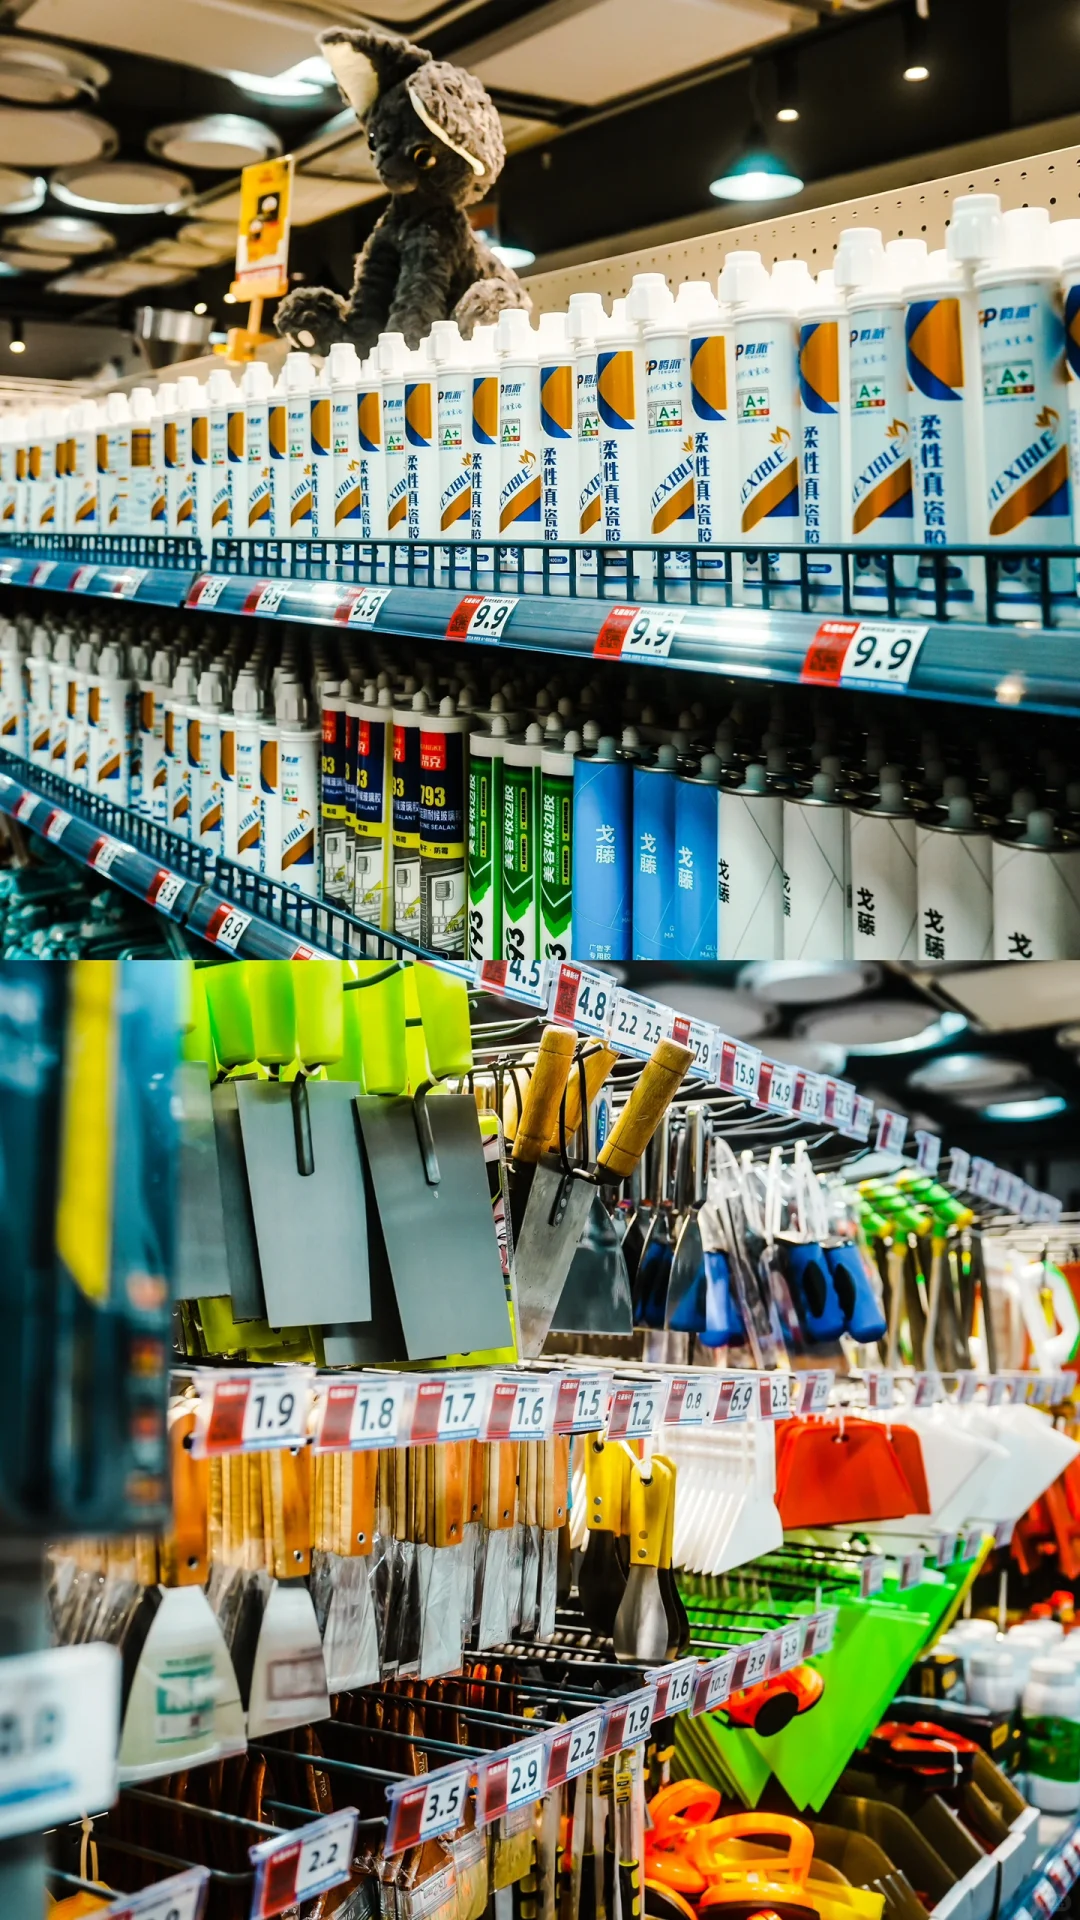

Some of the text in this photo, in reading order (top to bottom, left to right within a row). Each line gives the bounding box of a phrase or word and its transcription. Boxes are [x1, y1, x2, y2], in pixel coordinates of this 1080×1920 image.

[1001, 368, 1029, 384] A+
[746, 395, 765, 408] A+
[859, 384, 881, 398] A+
[584, 418, 598, 429] A+
[659, 406, 679, 419] A+
[388, 435, 401, 444] A+
[444, 429, 459, 439] A+
[503, 424, 518, 435] A+
[602, 439, 621, 541] 柔性真瓷胶
[695, 432, 713, 542] 柔性真瓷胶
[353, 595, 381, 616] 9.9
[473, 605, 508, 629] 9.9
[630, 617, 674, 647] 9.9
[854, 636, 912, 670] 9.9
[543, 794, 555, 883] 美容收边胶
[595, 824, 615, 864] 戈藤
[640, 833, 656, 875] 戈藤
[678, 846, 693, 890] 戈藤
[857, 887, 876, 936] 戈藤
[222, 916, 243, 940] 9.9
[589, 944, 612, 952] 广告字
[509, 960, 541, 987] 4.5
[578, 986, 606, 1020] 4.8
[618, 1011, 638, 1035] 2.2
[643, 1021, 661, 1044] 2.5
[734, 1060, 755, 1085] 15.9
[771, 1080, 791, 1102] 14.9
[444, 1392, 475, 1424] 1.7
[578, 1389, 601, 1416] 1.5
[686, 1392, 702, 1409] 0.8
[730, 1387, 752, 1412] 6.9
[772, 1385, 788, 1407] 2.5
[254, 1393, 295, 1429] 1.9
[359, 1397, 394, 1431] 1.8
[517, 1396, 544, 1425] 1.6
[631, 1400, 653, 1426] 1.2
[783, 1638, 797, 1659] 3.9
[748, 1654, 766, 1675] 3.9
[671, 1673, 690, 1701] 1.6
[710, 1676, 727, 1693] 10.5
[628, 1705, 650, 1734] 1.9
[570, 1730, 596, 1762] 2.2
[510, 1759, 538, 1795] 2.9
[426, 1785, 460, 1822] 3.5
[308, 1843, 339, 1872] 2.2
